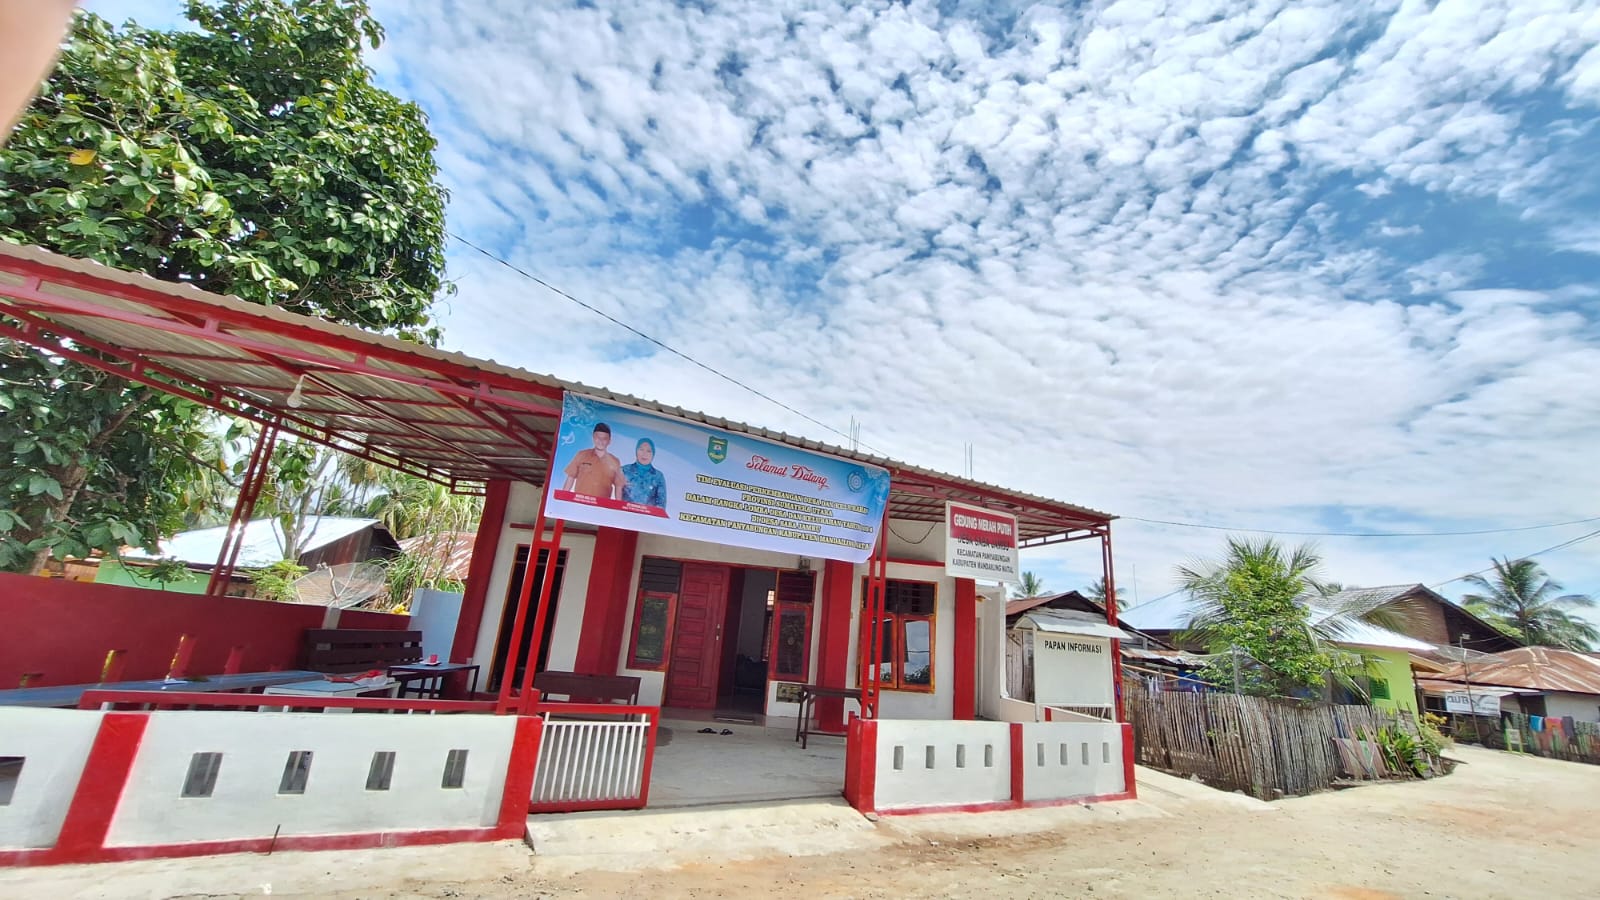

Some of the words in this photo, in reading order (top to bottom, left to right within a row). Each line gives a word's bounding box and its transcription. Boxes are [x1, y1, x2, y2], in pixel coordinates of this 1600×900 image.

[696, 474, 712, 484] TIM
[712, 477, 747, 491] EVALUASI
[746, 455, 788, 475] Selamat
[790, 465, 830, 490] Datang
[686, 492, 713, 505] DALAM
[713, 498, 743, 511] RANGKA
[744, 503, 769, 515] LOMBA
[769, 509, 788, 519] DESA
[742, 493, 775, 506] PROVINSI
[775, 499, 811, 513] SUMATERA
[812, 507, 833, 517] UTARA
[679, 512, 726, 527] KECAMATAN
[727, 520, 777, 536] PANYABUNGAN
[751, 514, 760, 523] DI
[760, 515, 779, 526] DESA
[954, 513, 977, 530] GEDUNG
[978, 518, 996, 533] MERAH
[997, 522, 1011, 536] PUTIH
[952, 558, 977, 569] KABUPATEN
[957, 548, 981, 559] KECAMATAN
[1044, 640, 1066, 651] PAPAN
[1067, 641, 1102, 654] INFORMASI
